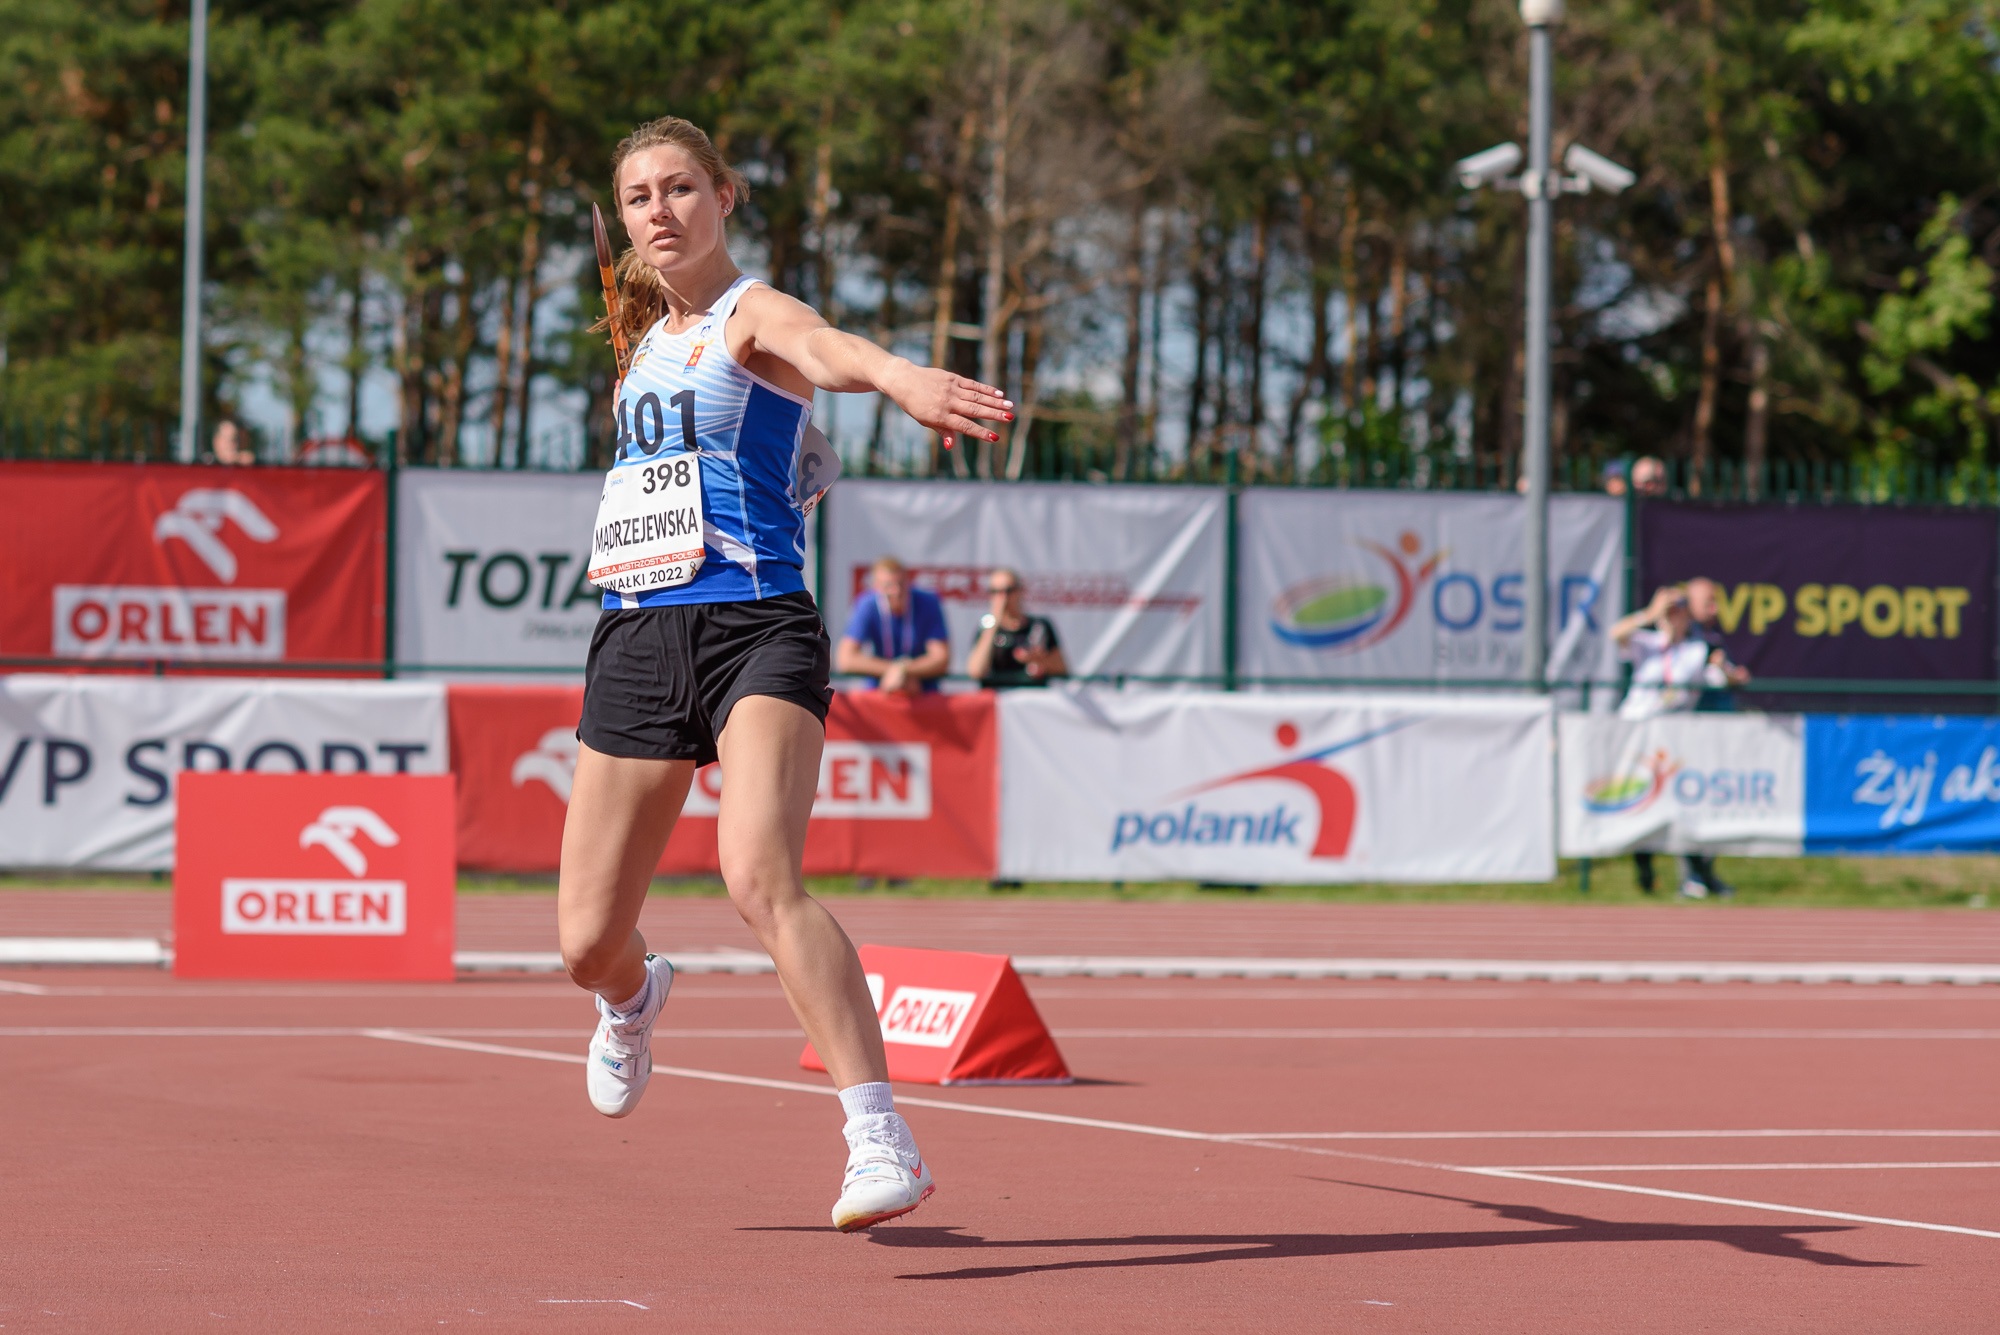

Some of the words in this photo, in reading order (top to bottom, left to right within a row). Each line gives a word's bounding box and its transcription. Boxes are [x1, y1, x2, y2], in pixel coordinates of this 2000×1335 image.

[617, 390, 700, 460] 401
[642, 460, 691, 494] 398
[595, 507, 698, 556] MĄDRZEJEWSKA
[601, 565, 618, 575] PZLA
[618, 556, 671, 571] MISTRZOSTWA
[672, 550, 700, 561] POLSKI
[649, 566, 684, 584] 2022
[71, 602, 266, 643] ORLEN
[1433, 574, 1599, 632] OSR
[1712, 583, 1785, 635] VP
[1794, 583, 1970, 638] SPORT
[698, 758, 909, 801] OEN
[1674, 769, 1776, 806] OSIR
[1854, 751, 1938, 828] Żyj
[1111, 803, 1303, 854] polanik
[238, 891, 389, 922] ORLEN
[887, 998, 963, 1036] ORLEN
[601, 1055, 623, 1070] NIKE
[854, 1166, 881, 1177] NIKE
